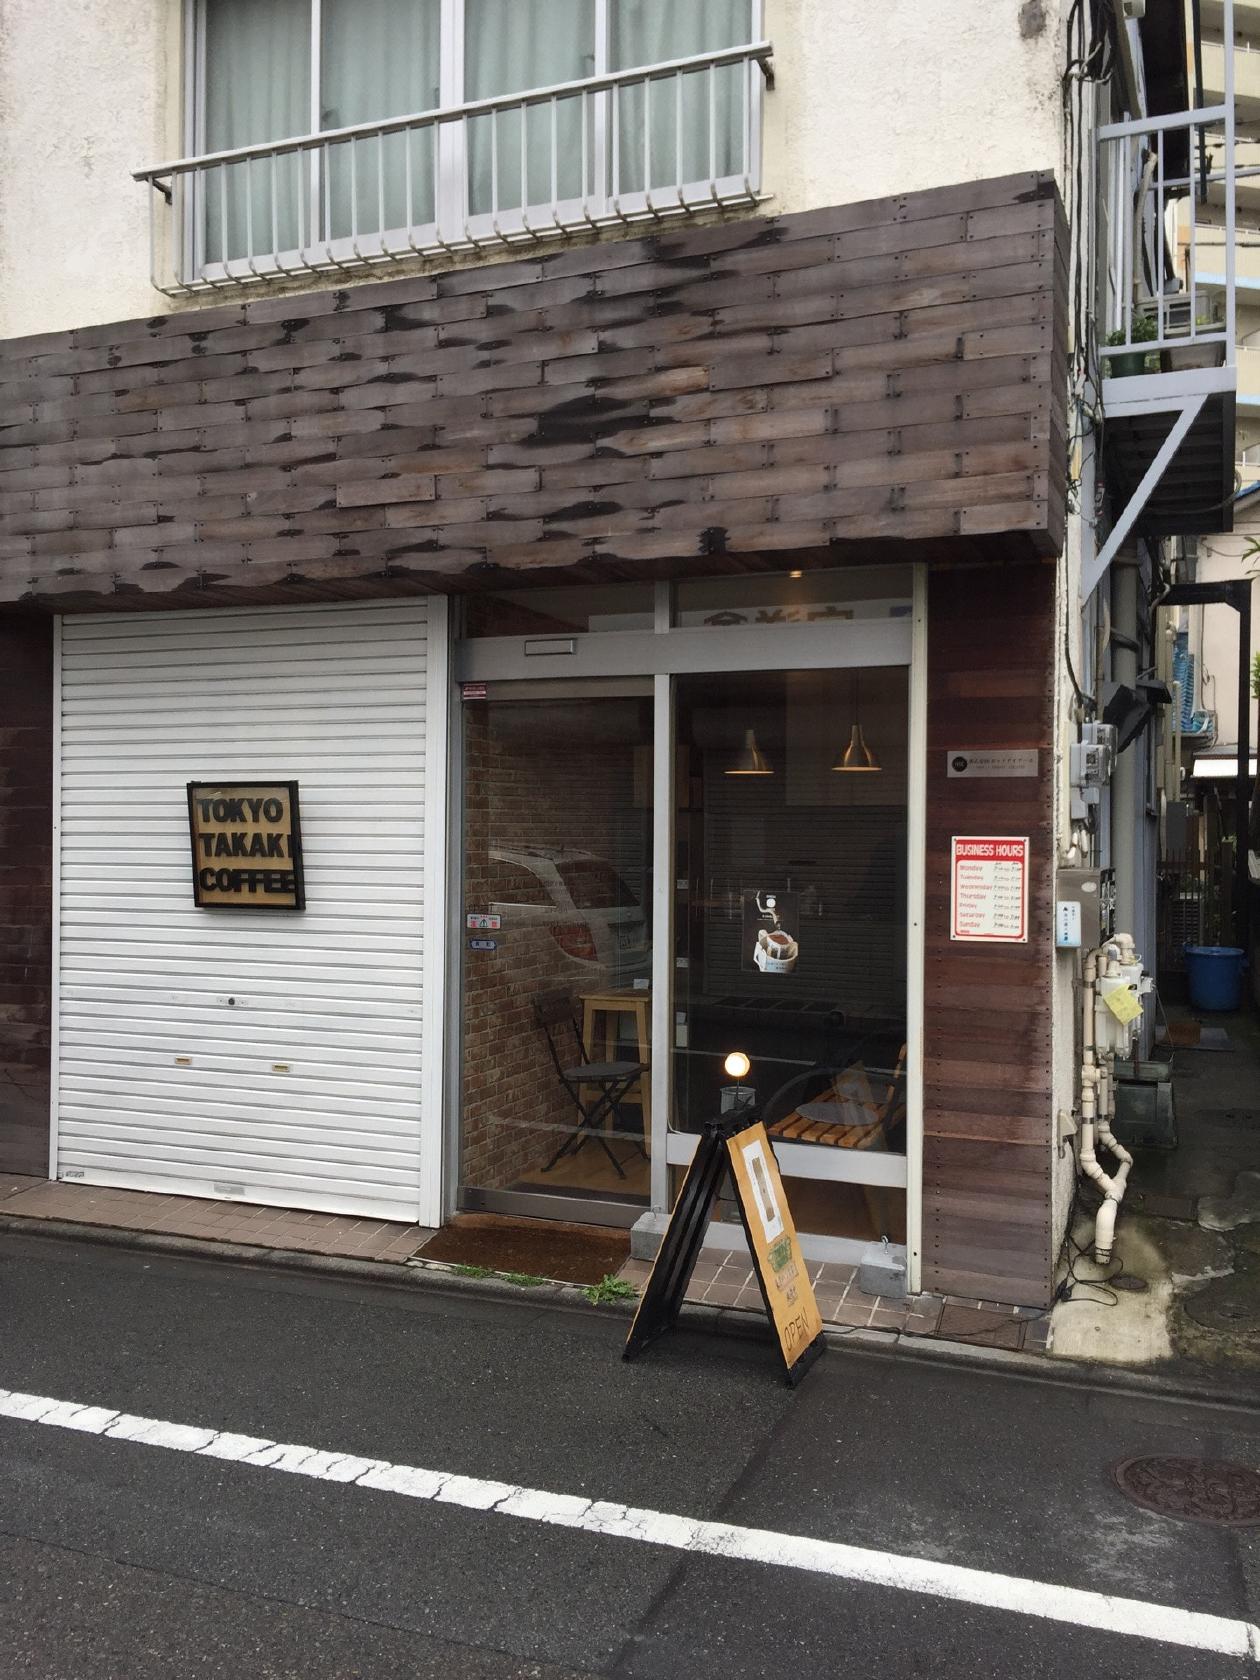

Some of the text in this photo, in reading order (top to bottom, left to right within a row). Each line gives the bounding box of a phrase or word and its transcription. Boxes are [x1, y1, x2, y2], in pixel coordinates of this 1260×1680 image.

[197, 797, 283, 823] TOKYO
[198, 832, 294, 858] TAKAKI
[956, 844, 1024, 857] BUSINESS HOURS
[199, 867, 296, 893] COFFEE
[783, 1306, 810, 1351] OPEN
